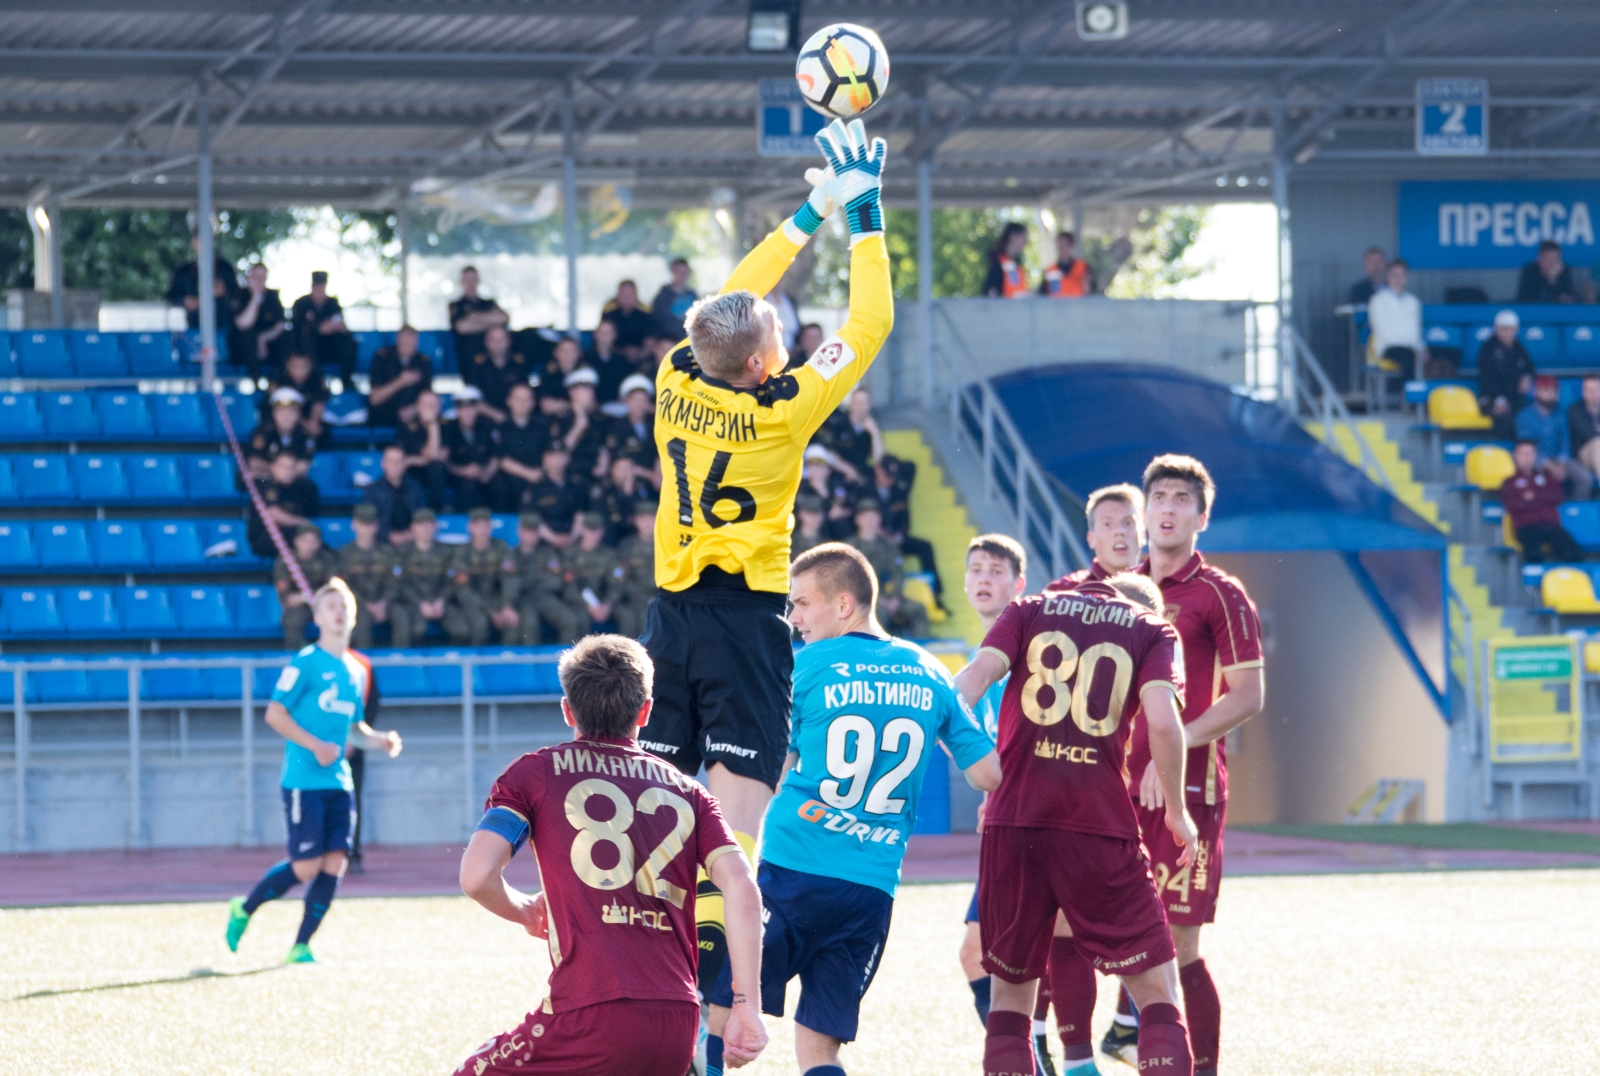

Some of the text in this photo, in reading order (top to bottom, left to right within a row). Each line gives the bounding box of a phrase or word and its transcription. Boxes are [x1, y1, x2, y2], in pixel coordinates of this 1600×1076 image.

[1439, 101, 1467, 132] 2
[1438, 201, 1595, 247] ПРЕССА
[666, 437, 757, 529] 16
[855, 663, 924, 676] РОССИЯ
[1021, 630, 1133, 737] 80
[823, 680, 934, 711] КУЛЬТИНОВ
[639, 740, 680, 755] TNEFT
[710, 742, 758, 759] TATNEFT
[818, 714, 925, 815] 92
[564, 778, 696, 910] 82
[1155, 861, 1192, 903] 94
